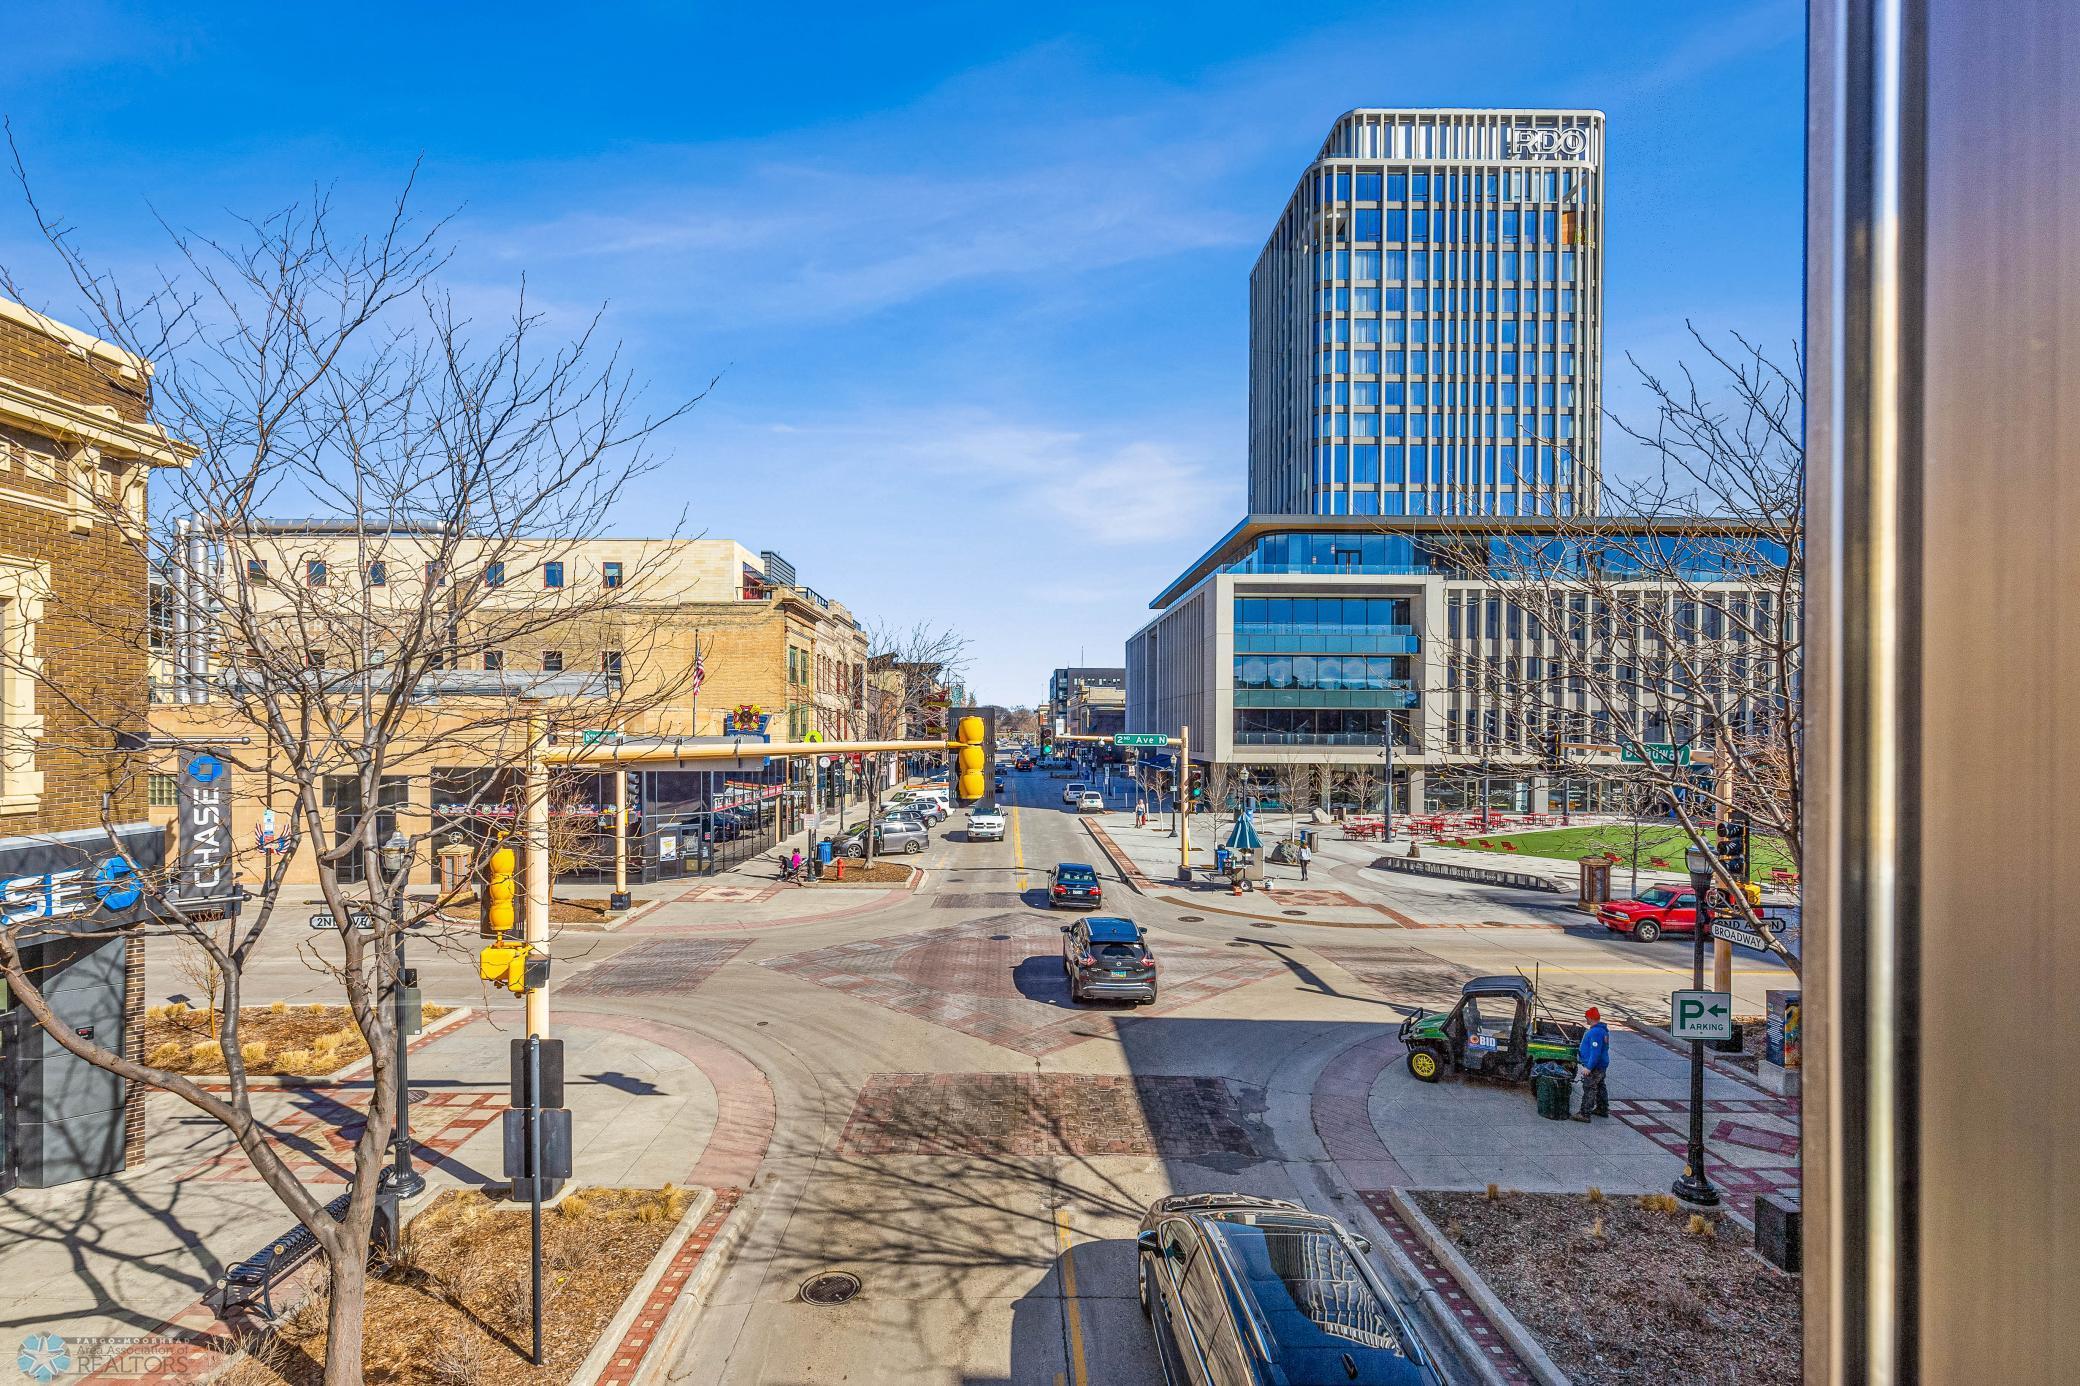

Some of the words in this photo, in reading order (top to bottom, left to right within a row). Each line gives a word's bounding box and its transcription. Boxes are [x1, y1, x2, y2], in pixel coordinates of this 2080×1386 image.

[1513, 128, 1588, 154] RDO
[1136, 736, 1154, 744] Ave
[1159, 736, 1166, 744] N
[193, 786, 220, 888] CHASE
[1771, 920, 1780, 930] N
[1714, 925, 1762, 948] BROADWAY
[1479, 1035, 1496, 1046] BID
